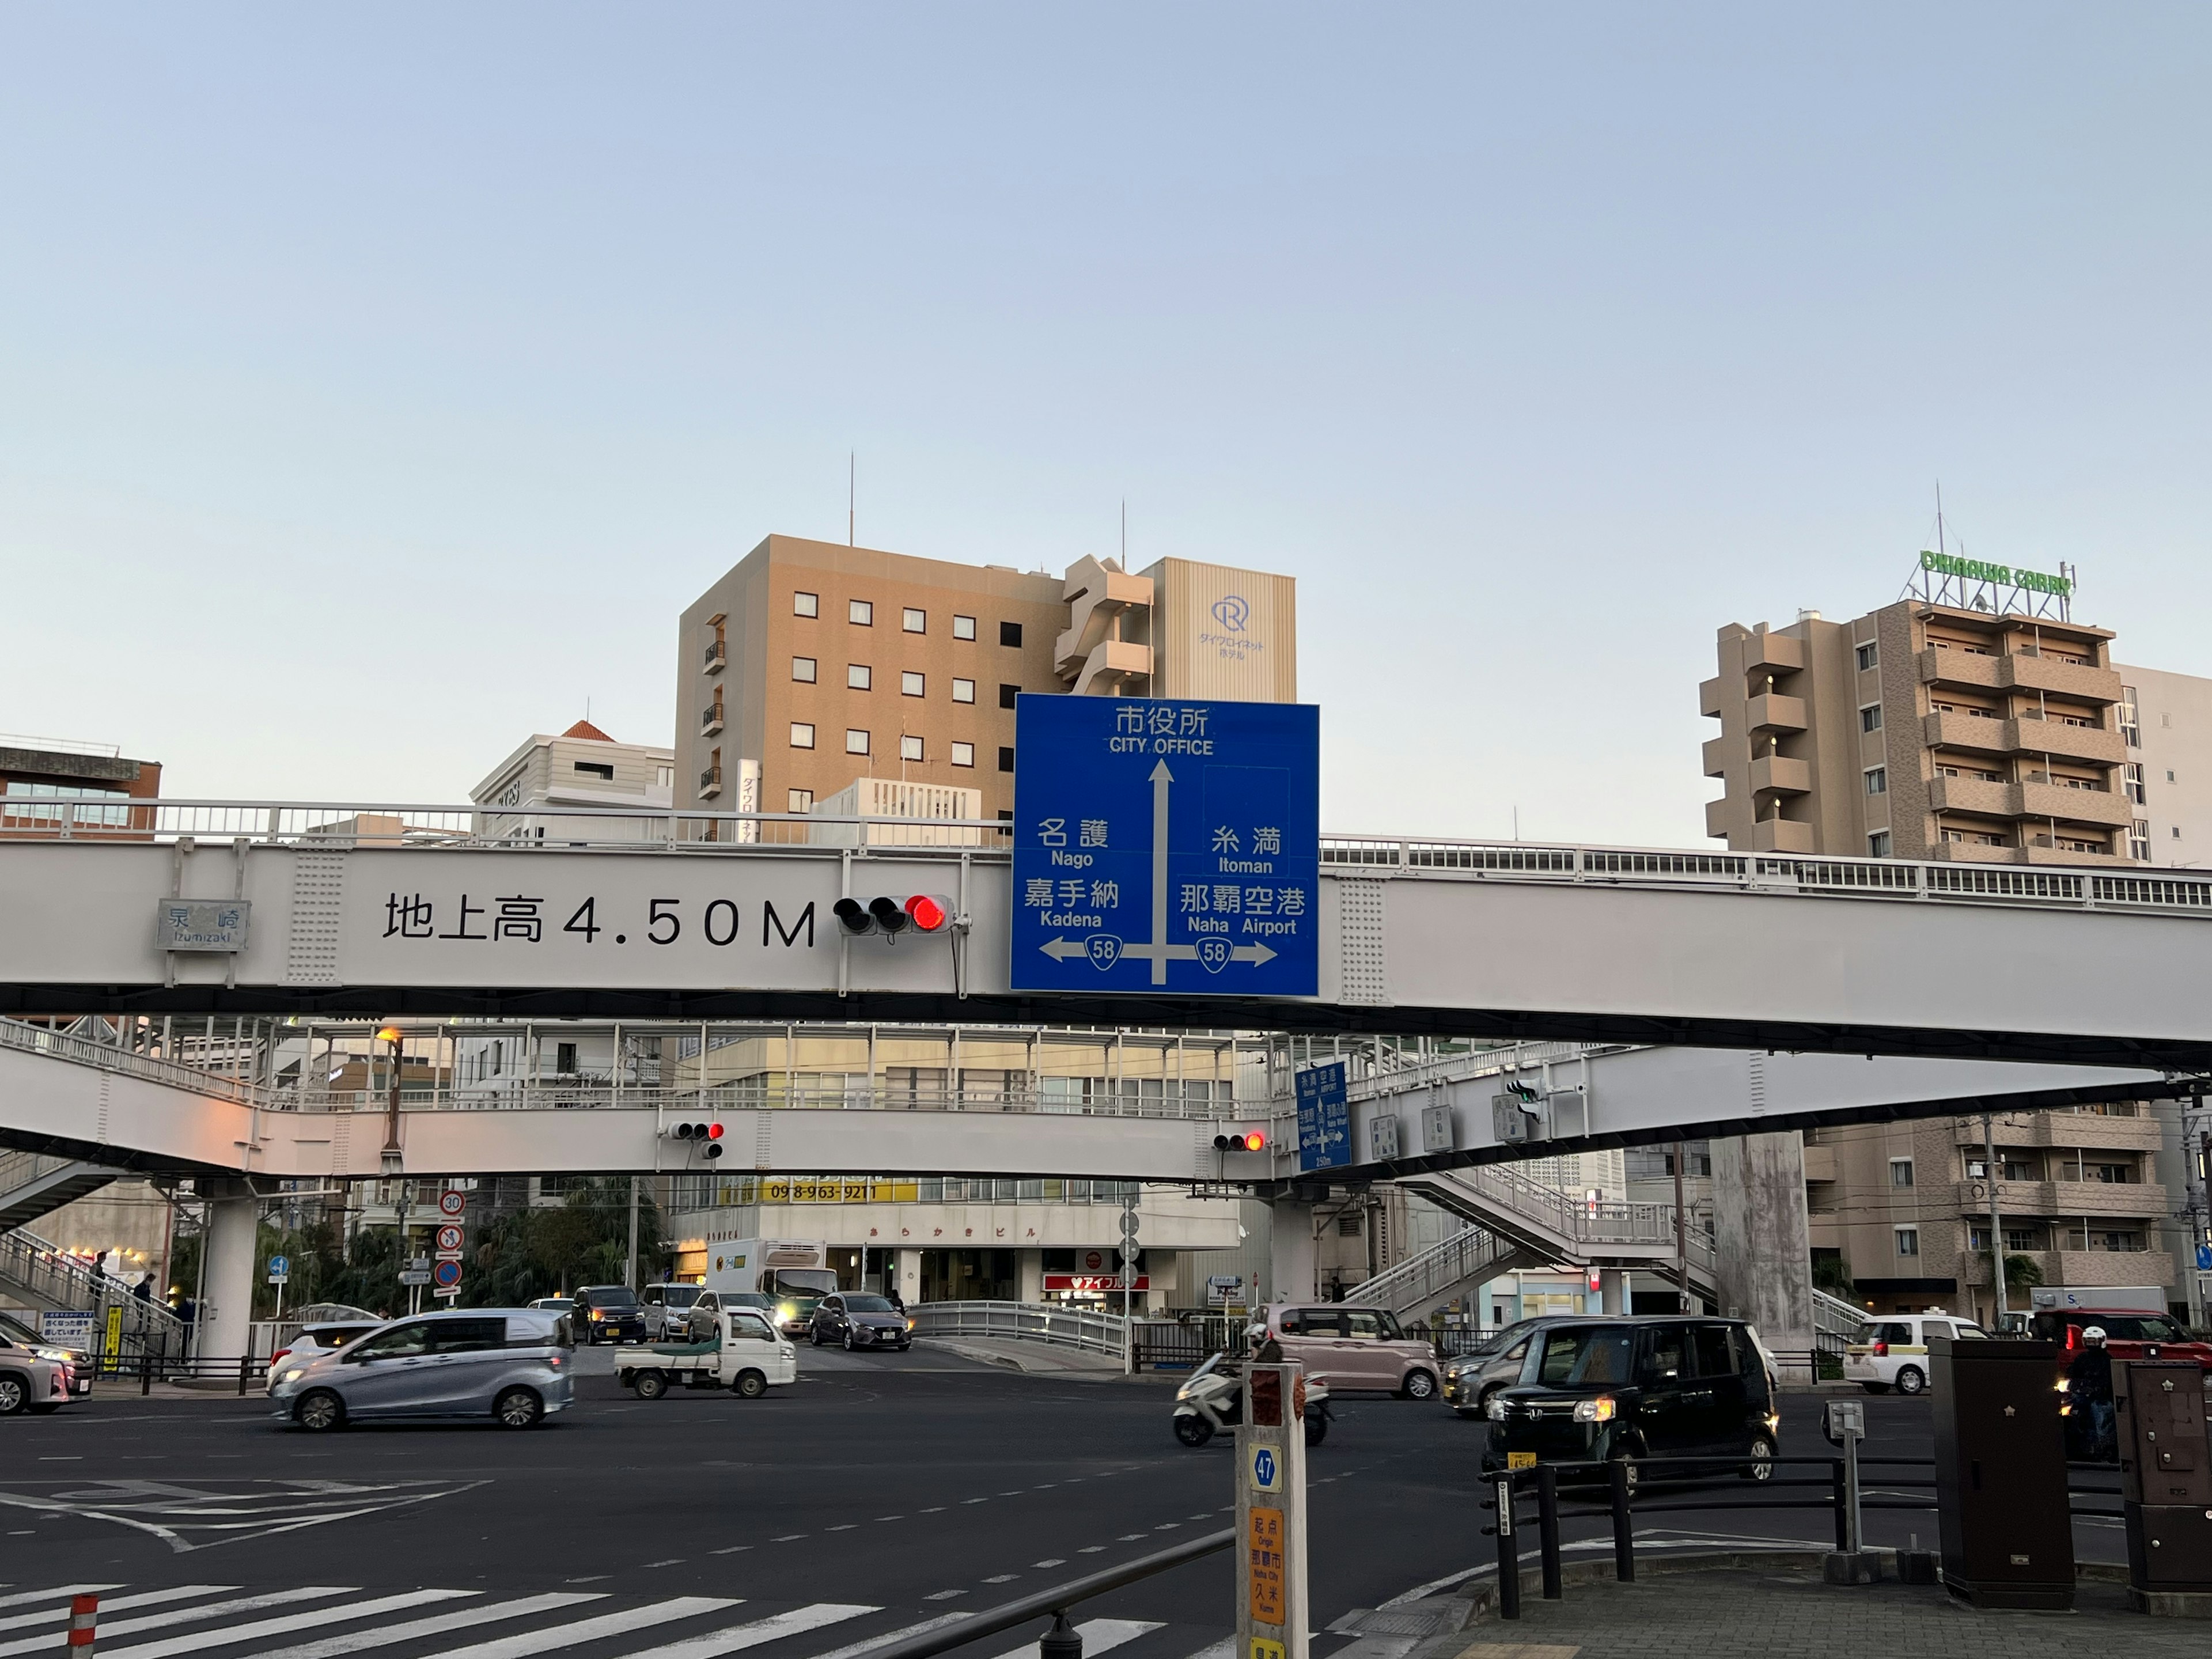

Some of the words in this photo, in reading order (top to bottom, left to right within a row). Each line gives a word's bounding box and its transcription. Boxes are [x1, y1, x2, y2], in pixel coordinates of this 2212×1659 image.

[1921, 550, 2010, 585] OKINAWA
[2014, 569, 2070, 597] CARRY
[1199, 634, 1263, 651] ダイワロイネット
[1219, 649, 1245, 660] ホテル
[1116, 706, 1208, 736] 市役所
[1109, 737, 1146, 753] CITY
[1154, 738, 1213, 756] OFFICE
[1037, 818, 1108, 848] 名護
[1212, 825, 1281, 855] 糸満
[1051, 851, 1093, 869] Nago
[1219, 858, 1272, 874] Itoman
[1024, 878, 1118, 908] 嘉手納
[1181, 884, 1305, 916] 那覇空港
[169, 908, 240, 929] 泉崎
[1040, 911, 1101, 927] Kadena
[1188, 916, 1229, 933] Naha
[1242, 918, 1297, 937] Airport
[175, 931, 230, 943] Izumizaki
[1092, 941, 1115, 957] 58
[1203, 943, 1225, 961] 58
[445, 1198, 460, 1208] 30
[1084, 1277, 1125, 1289] アイフル
[1257, 1457, 1272, 1479] 47
[1255, 1517, 1277, 1536] 起点
[1251, 1549, 1281, 1569] 那覇市
[1255, 1582, 1278, 1602] 久米
